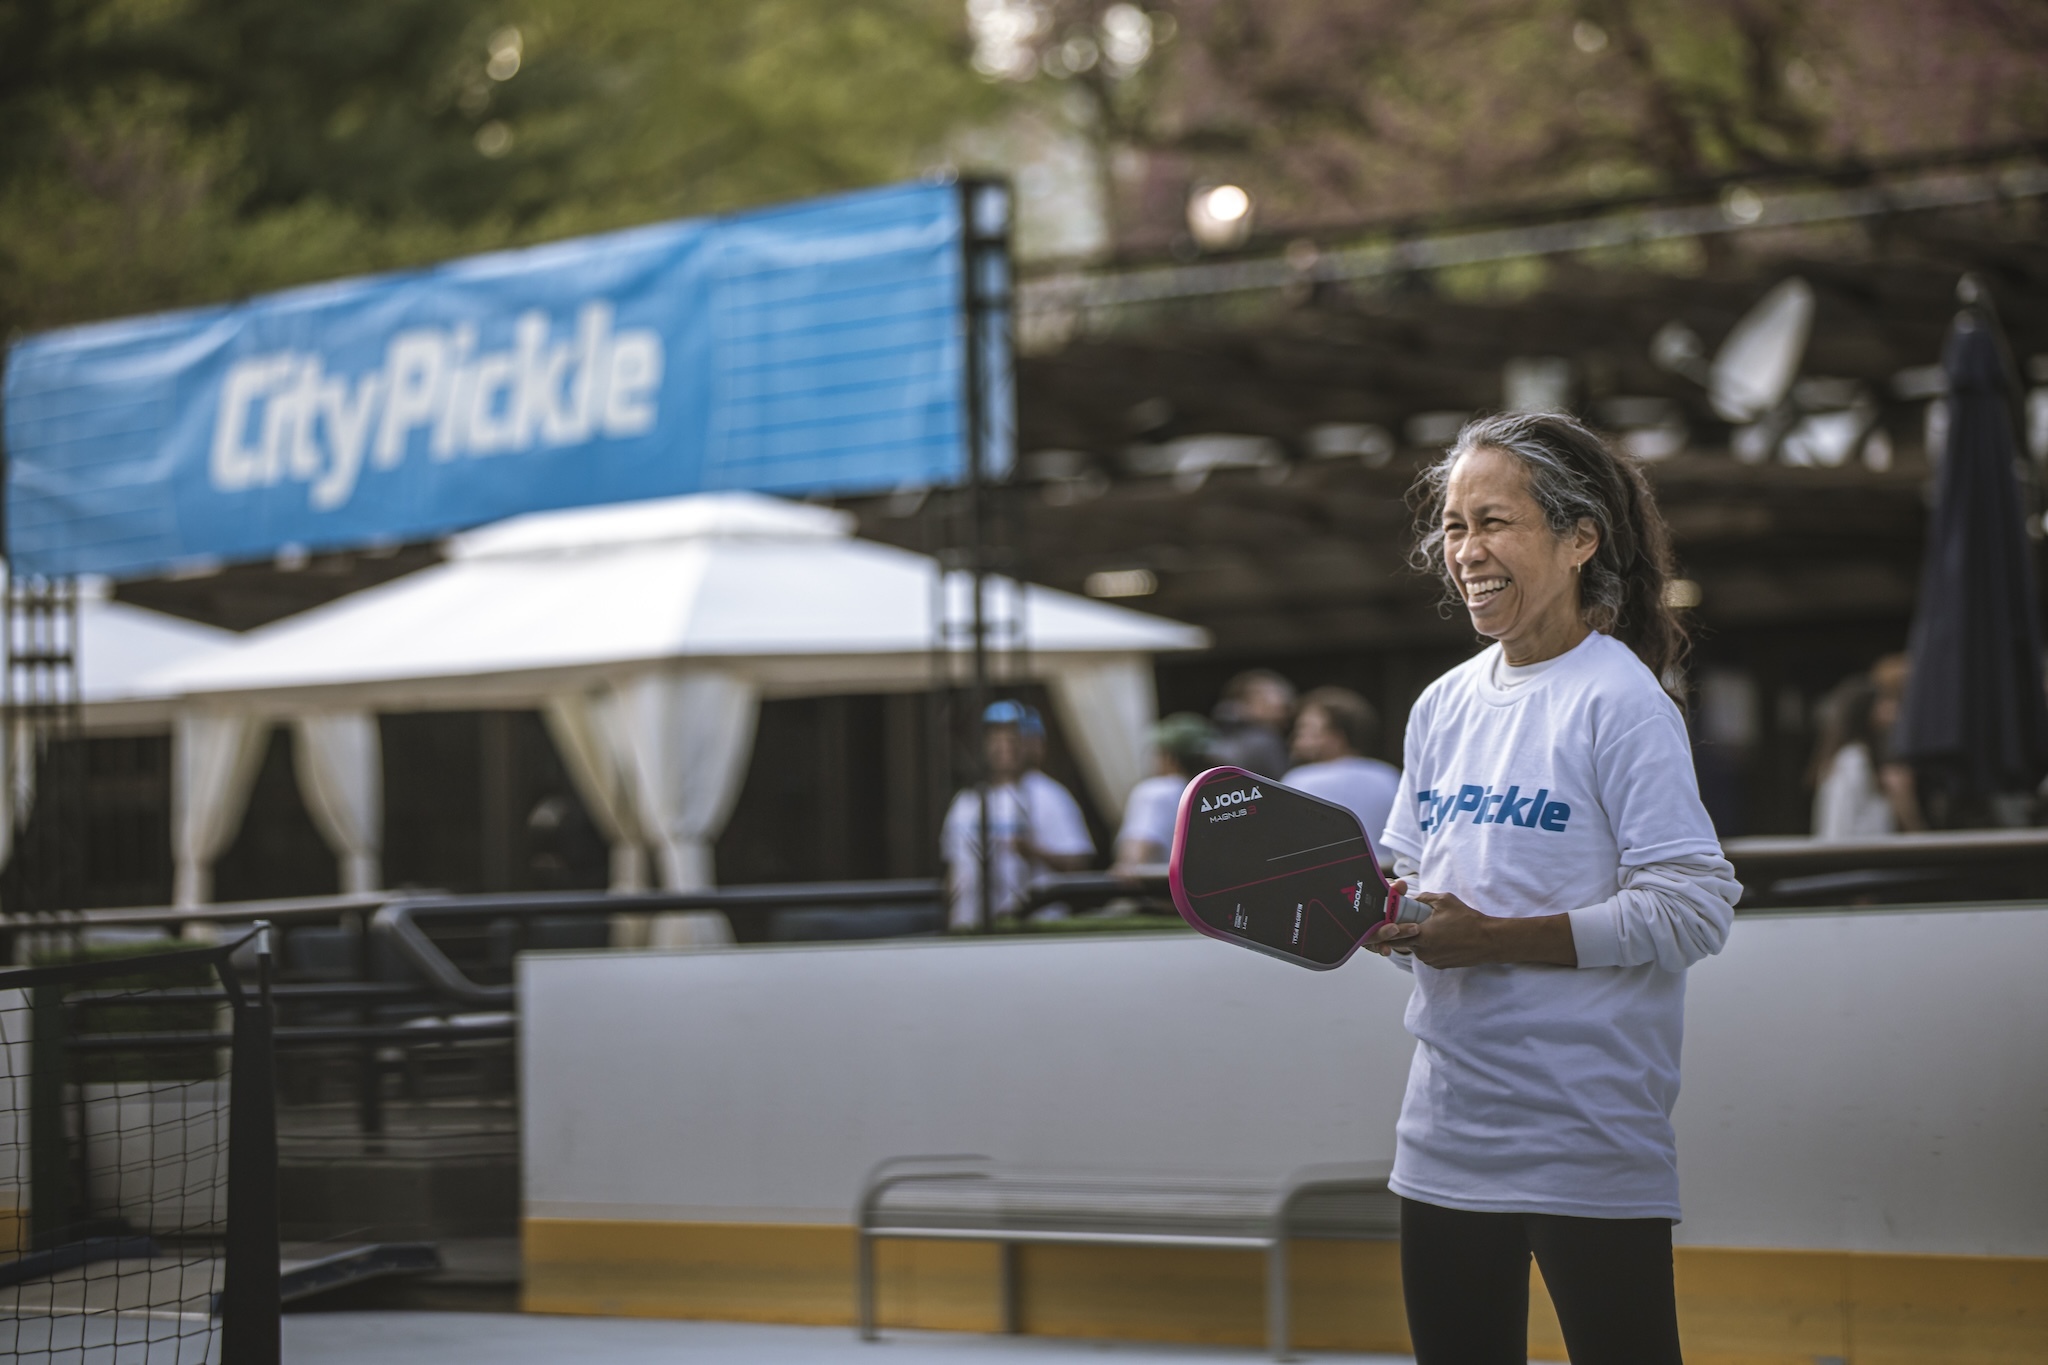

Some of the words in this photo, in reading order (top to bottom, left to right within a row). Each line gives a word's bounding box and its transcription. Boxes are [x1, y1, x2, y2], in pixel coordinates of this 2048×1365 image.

[210, 301, 664, 512] CityPickle
[1213, 786, 1263, 810] JOOLA
[1417, 784, 1571, 836] CtyPickle
[1209, 808, 1248, 824] MAGNUS
[1353, 881, 1363, 913] JOOLA
